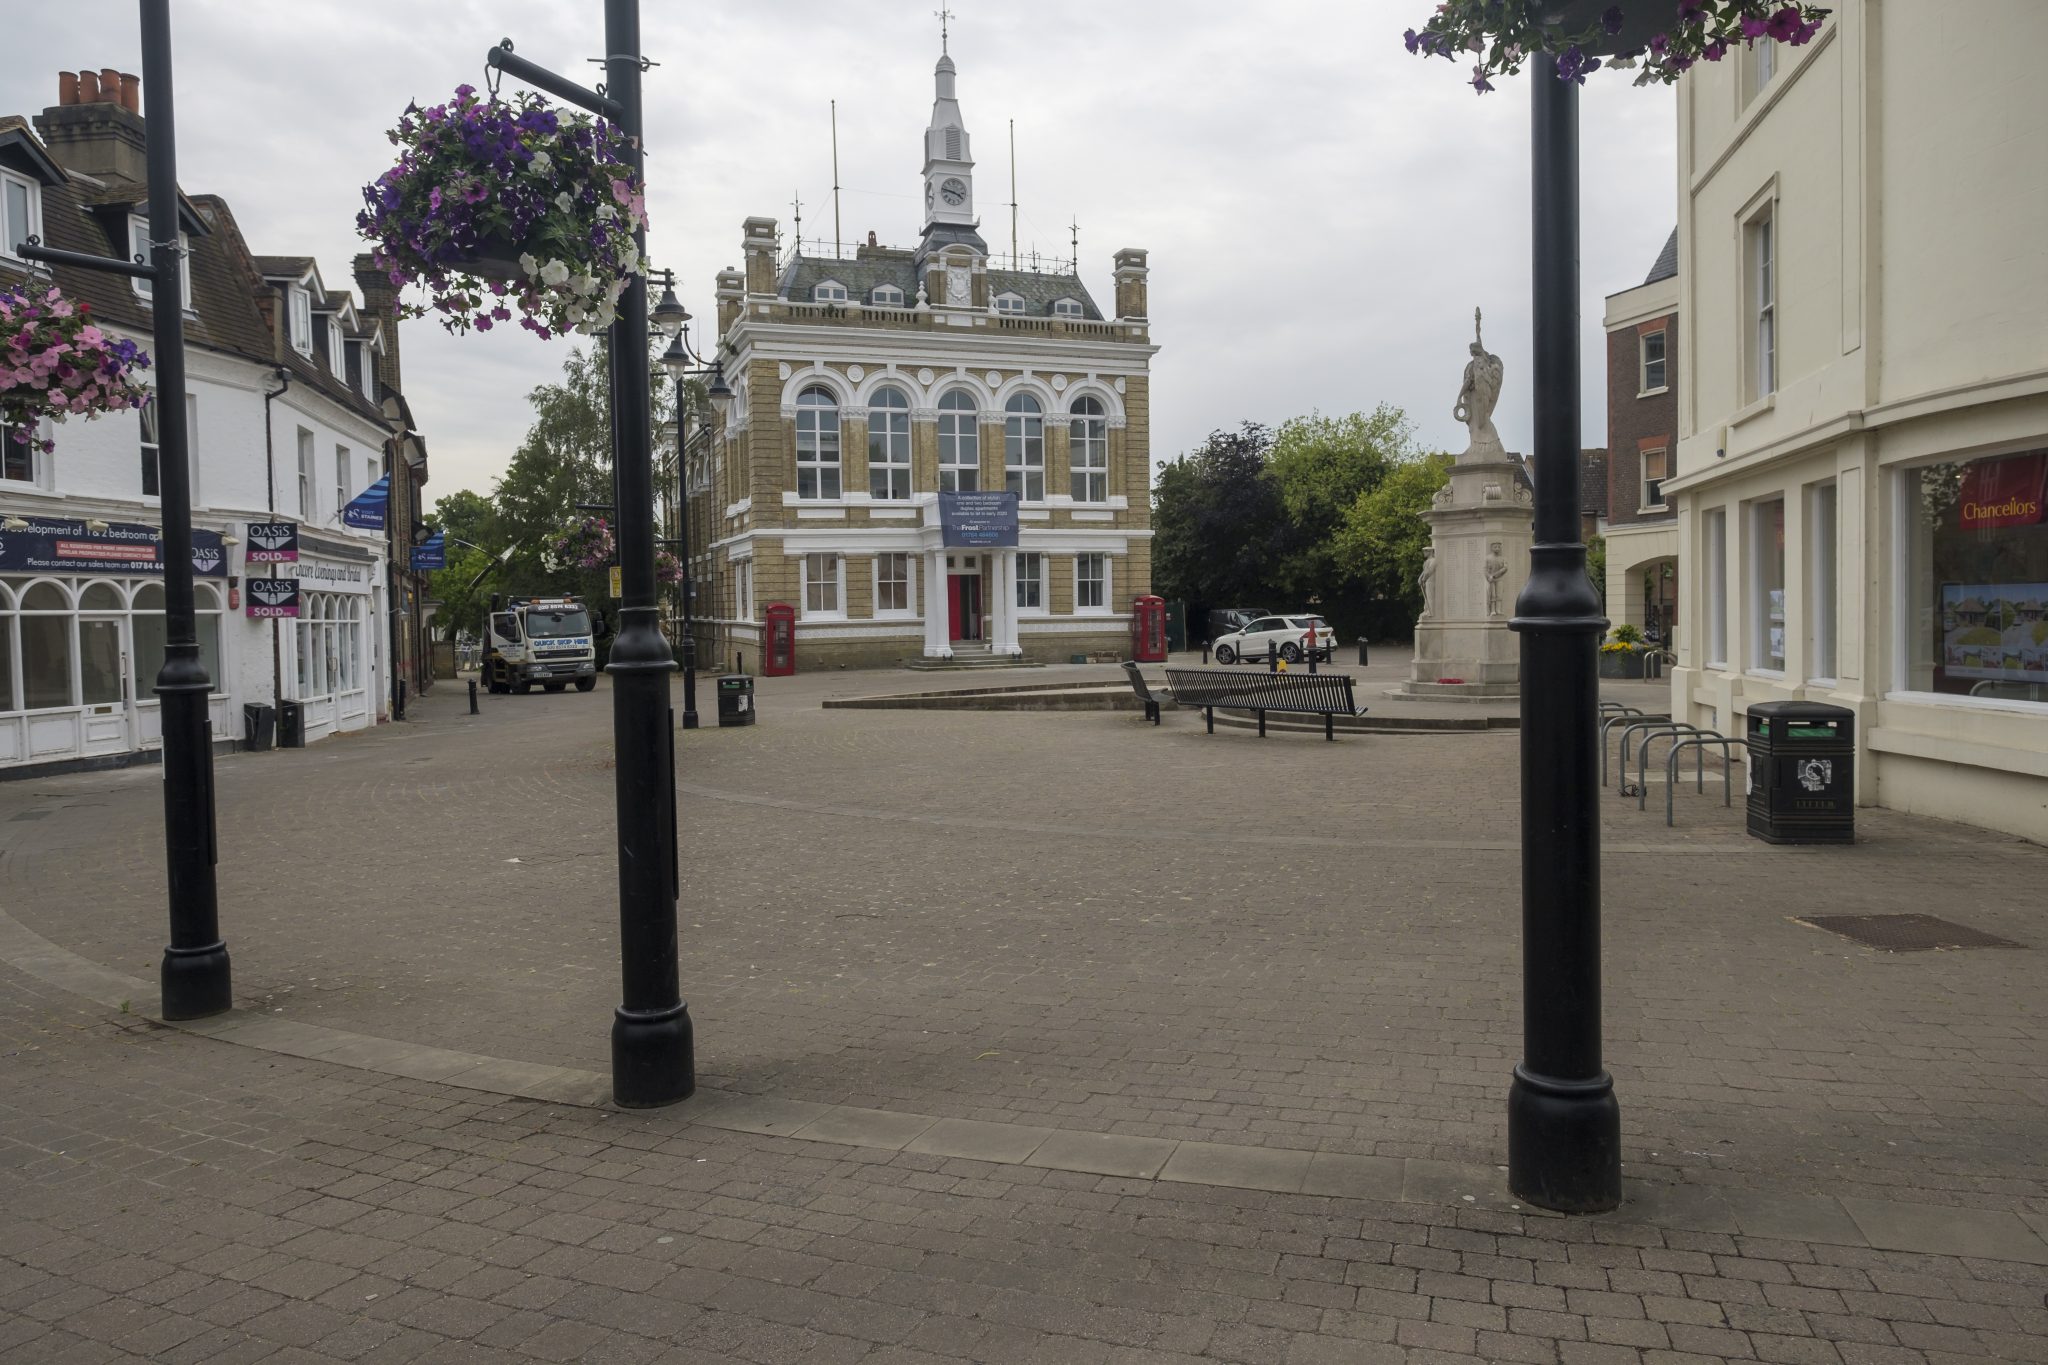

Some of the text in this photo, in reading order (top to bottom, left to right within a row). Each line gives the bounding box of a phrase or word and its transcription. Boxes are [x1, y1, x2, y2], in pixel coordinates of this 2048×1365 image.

[1964, 497, 2036, 520] Chancellors
[73, 524, 82, 536] of
[102, 528, 107, 537] 2
[109, 528, 147, 540] bedroom
[252, 552, 282, 561] SOLD
[27, 558, 49, 566] Please
[51, 559, 75, 567] contact
[254, 607, 283, 616] SOLD
